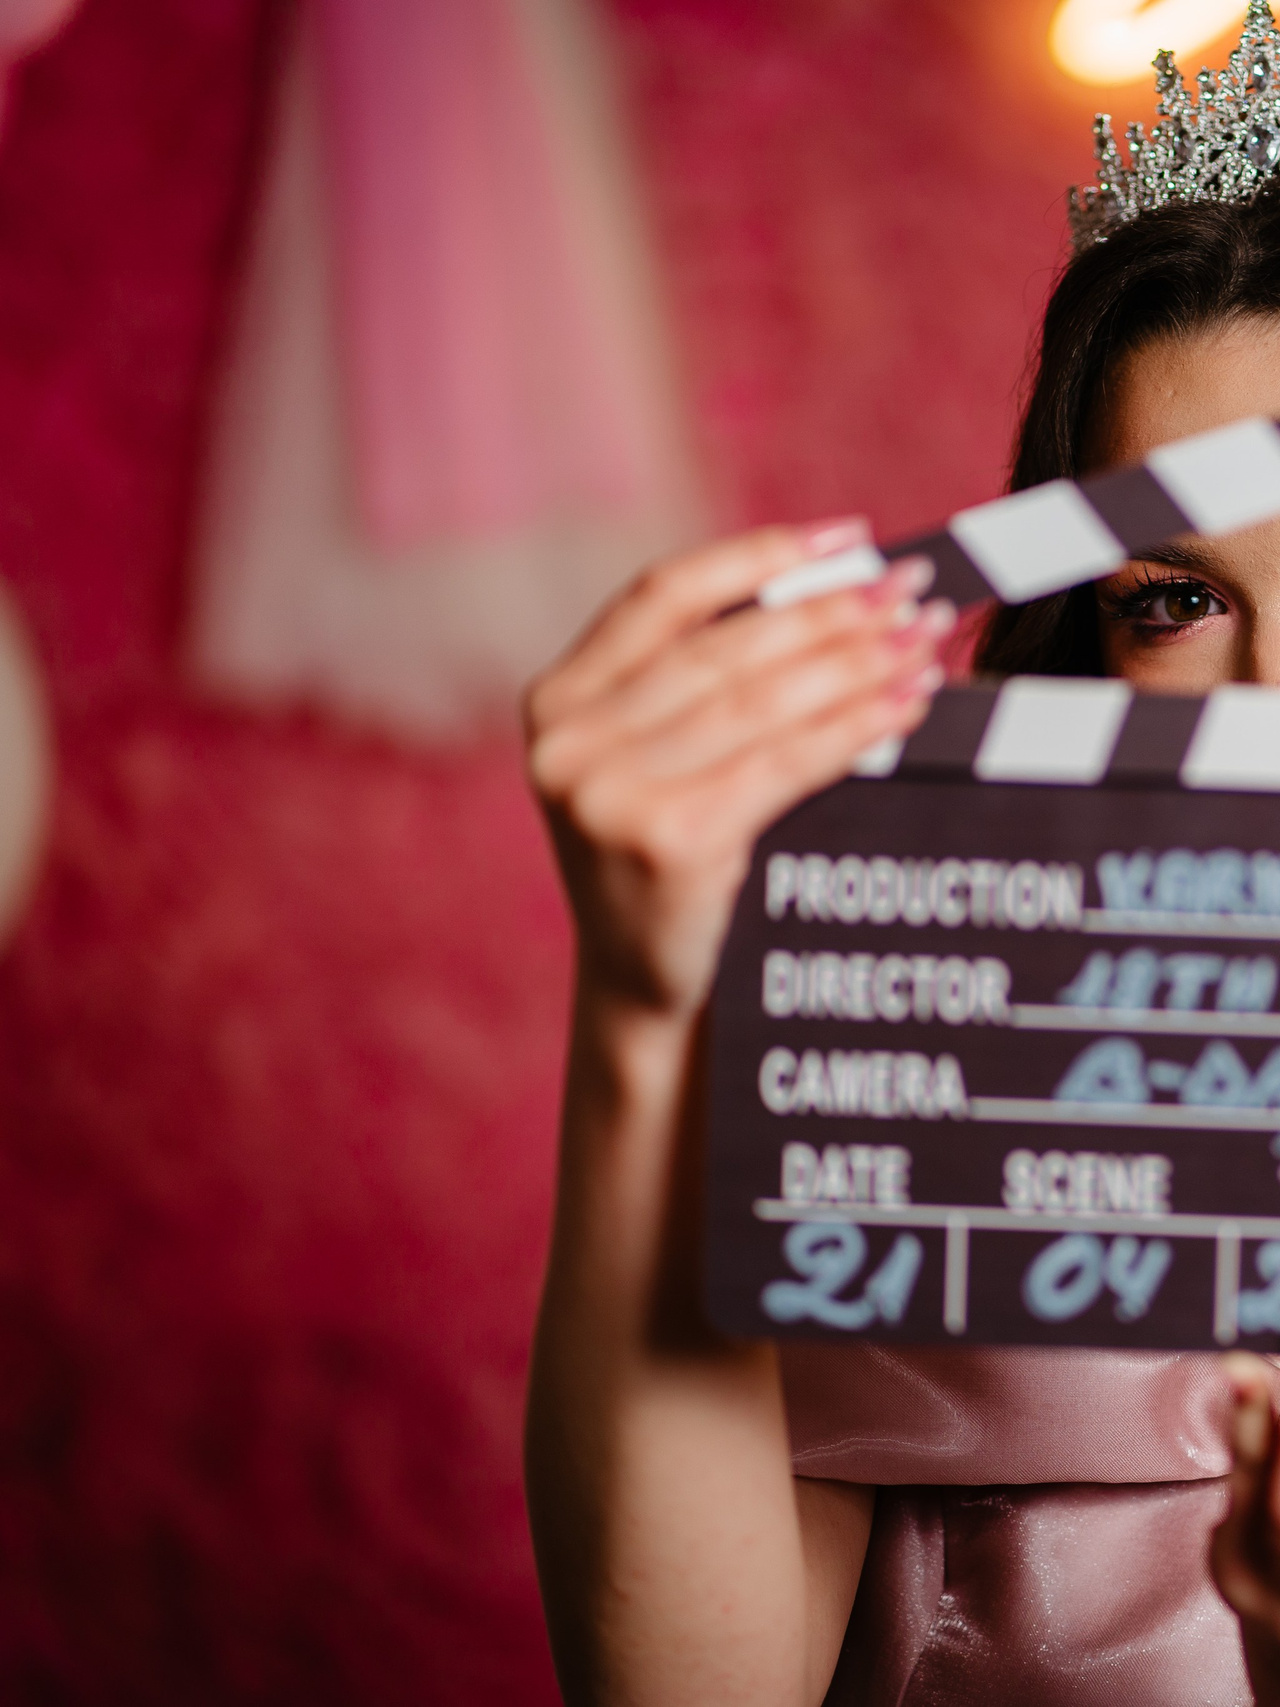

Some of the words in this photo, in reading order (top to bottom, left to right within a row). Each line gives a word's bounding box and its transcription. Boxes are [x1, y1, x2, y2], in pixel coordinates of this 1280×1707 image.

[764, 852, 1083, 931] PRODUCTION
[762, 950, 1011, 1026] DIRECTOR
[1056, 947, 1279, 1022] 18TH
[757, 1046, 968, 1122] CAMERA
[780, 1142, 911, 1207] DATE
[1003, 1149, 1173, 1216] SCENE
[760, 1216, 924, 1331] 21
[1022, 1231, 1174, 1323] 04
